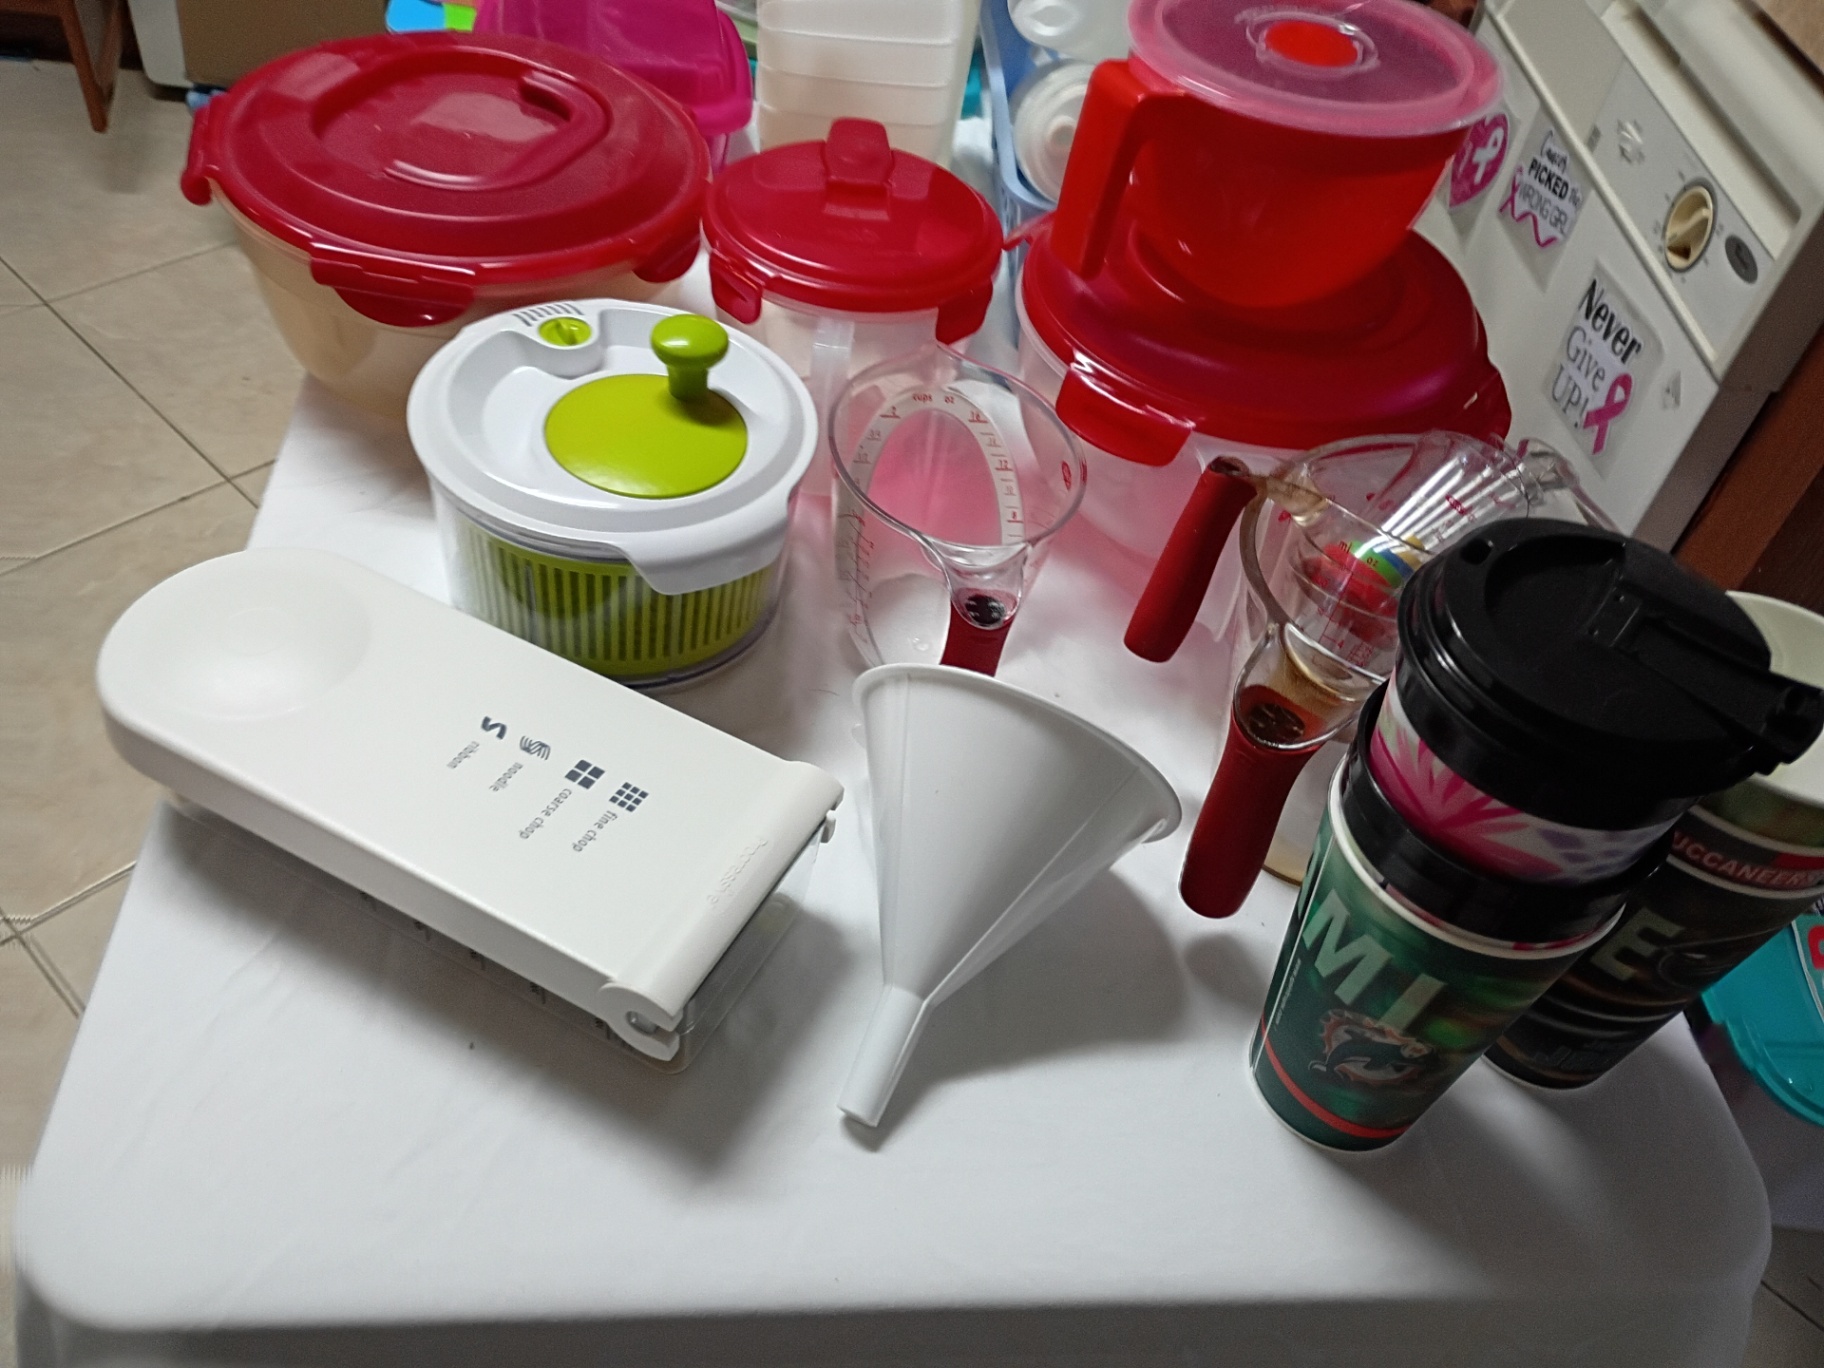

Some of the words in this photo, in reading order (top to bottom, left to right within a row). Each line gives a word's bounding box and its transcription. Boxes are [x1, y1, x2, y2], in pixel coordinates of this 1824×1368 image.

[1528, 157, 1570, 200] PICKED
[1578, 278, 1642, 364] Never
[1566, 325, 1606, 392] Give
[1551, 363, 1590, 429] UP!
[489, 762, 524, 793] noodle
[542, 788, 573, 818] coarse
[519, 816, 545, 840] chop
[594, 810, 619, 831] fine
[572, 829, 597, 853] chop
